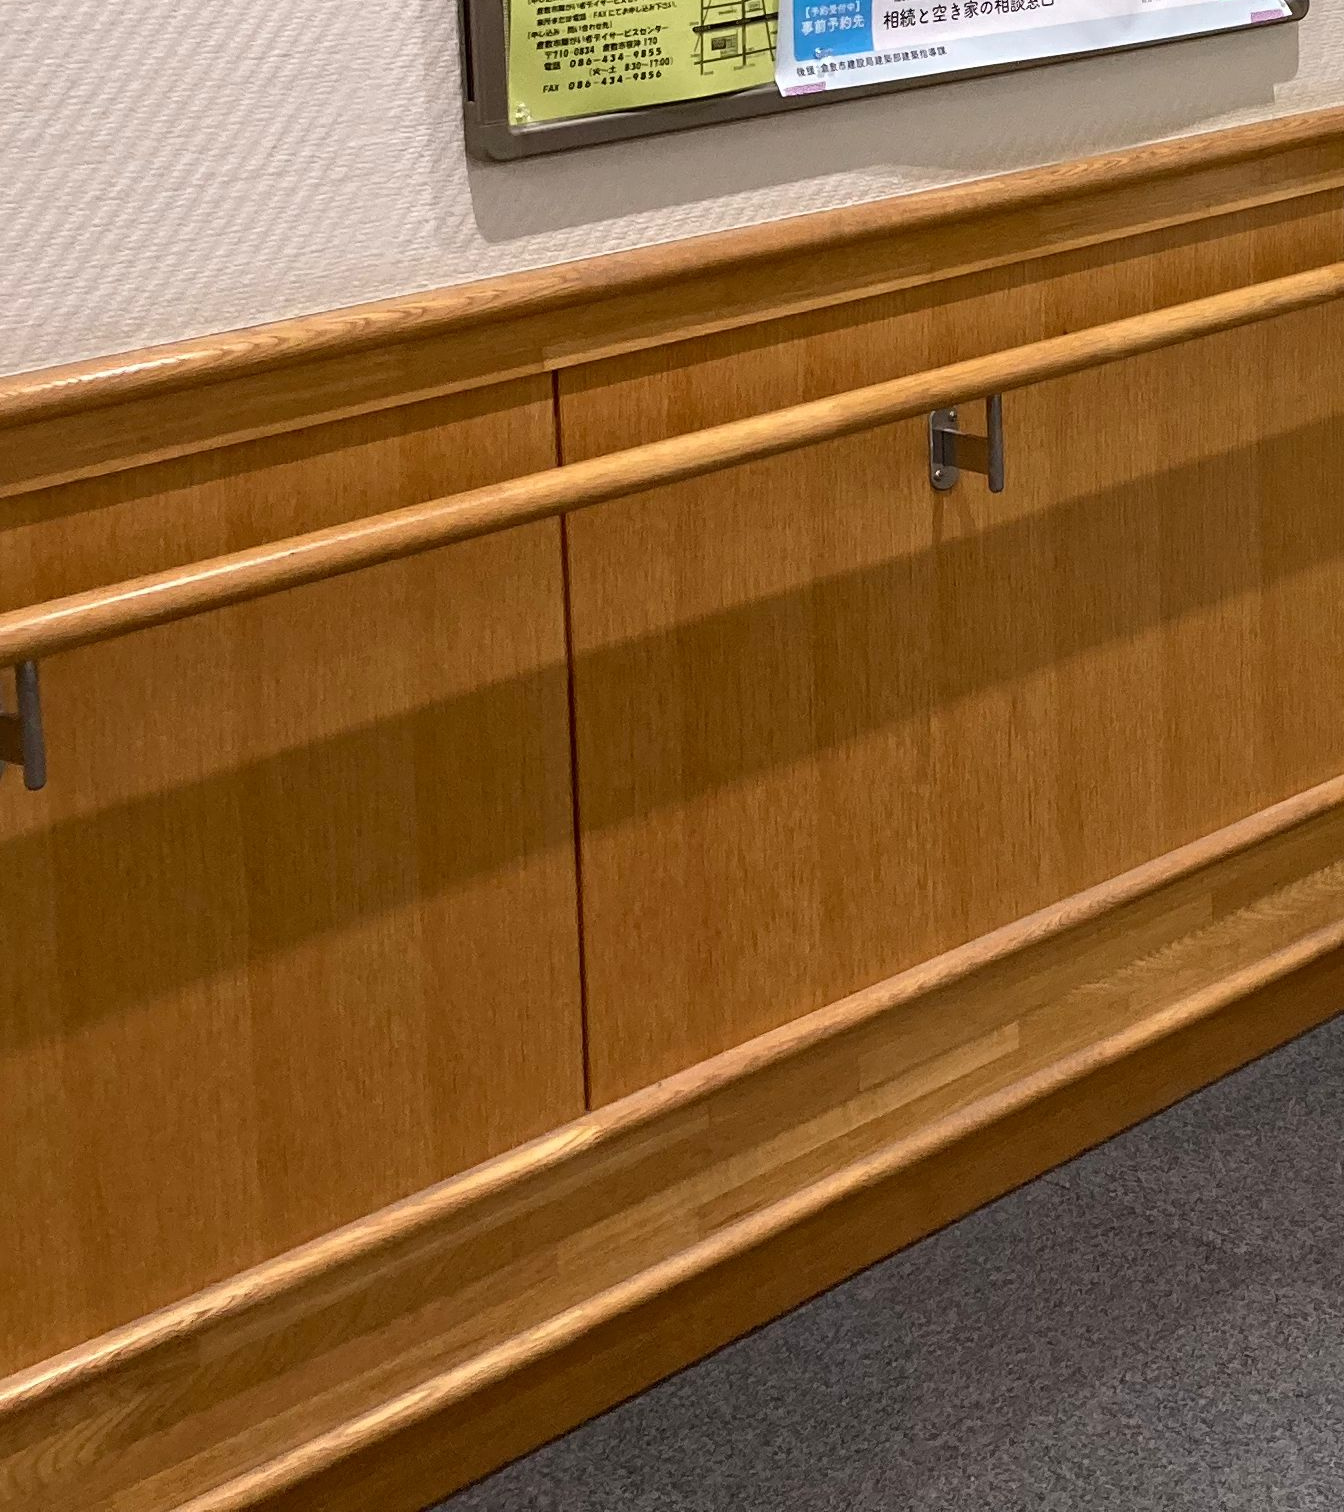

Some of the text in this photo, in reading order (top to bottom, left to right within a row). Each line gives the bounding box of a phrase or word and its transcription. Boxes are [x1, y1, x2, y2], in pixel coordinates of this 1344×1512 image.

[801, 16, 865, 37] 事前予約先
